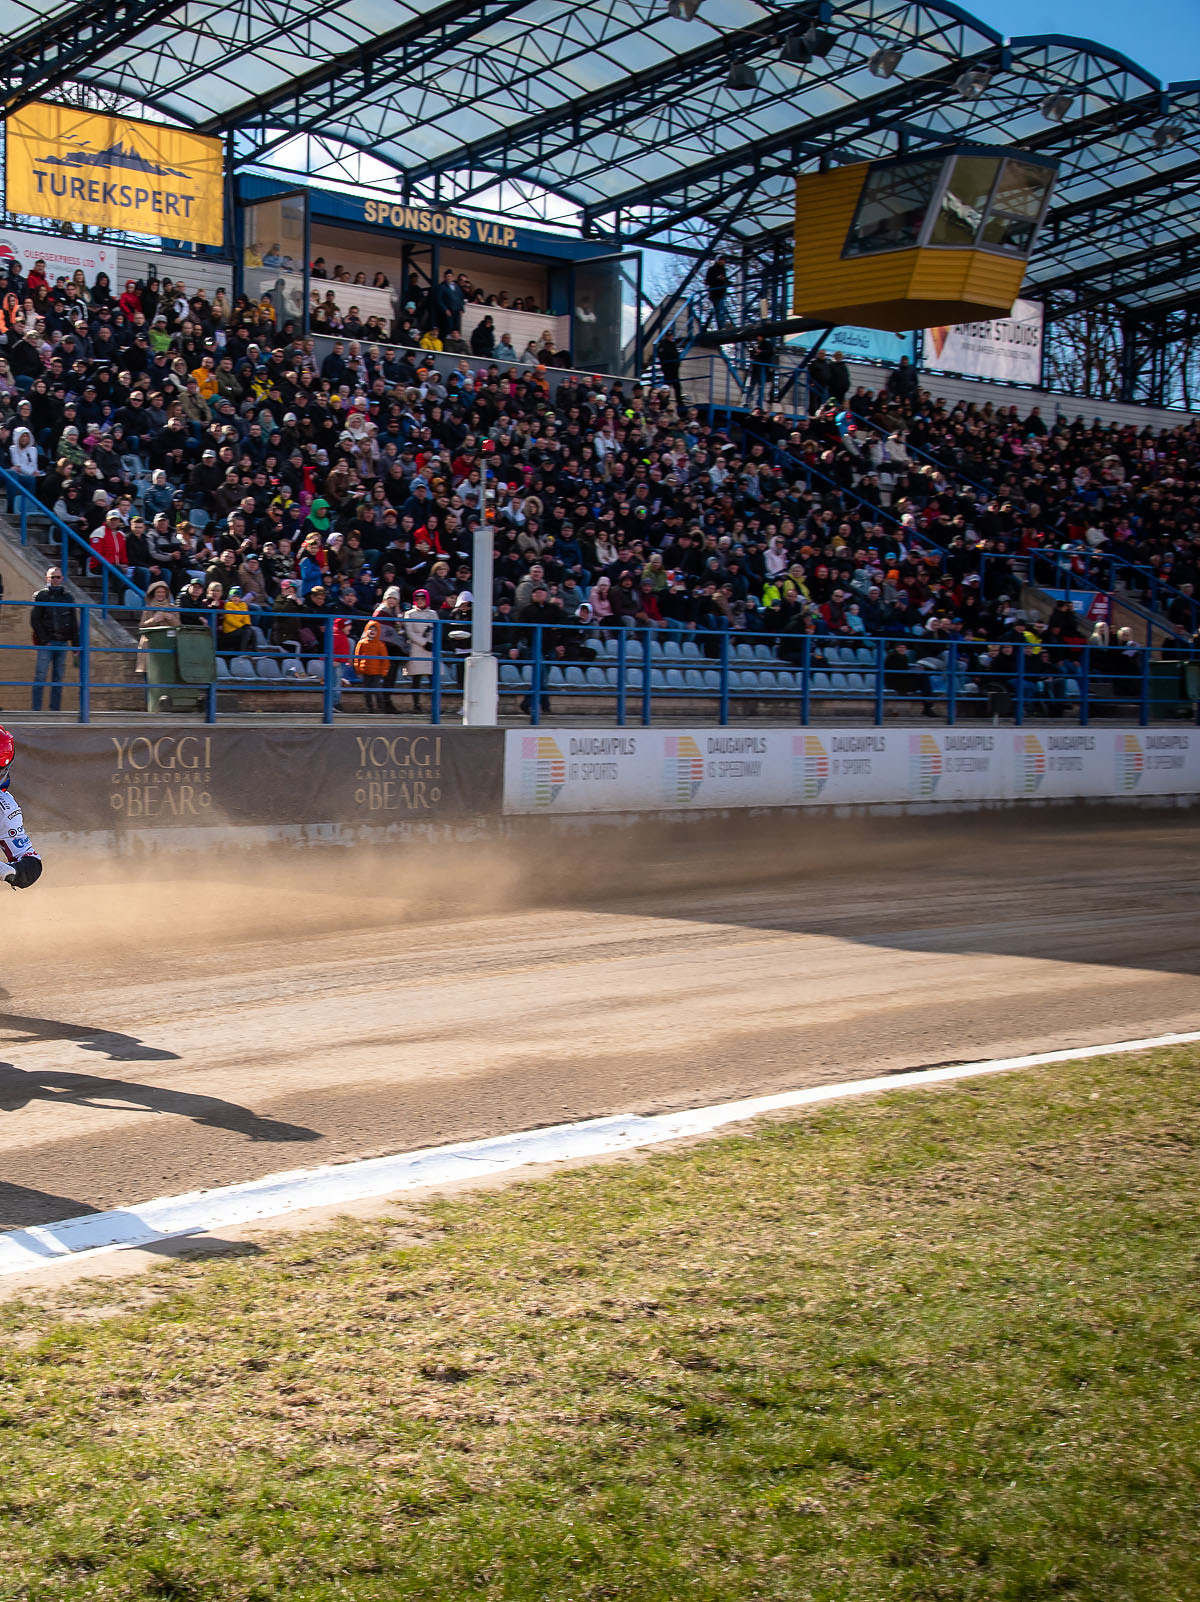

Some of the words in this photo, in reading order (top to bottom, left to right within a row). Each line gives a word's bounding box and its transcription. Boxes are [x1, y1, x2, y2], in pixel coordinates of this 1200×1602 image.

[32, 169, 195, 218] TUREKSPERT
[364, 200, 471, 239] SPONSORS
[475, 221, 518, 248] V.I.P.
[954, 320, 992, 340] AMBER
[995, 322, 1040, 347] STUDIOS
[111, 736, 211, 770] YOGGI
[356, 736, 441, 767] YOGGI
[569, 737, 636, 756] DAUGAVPILS
[707, 737, 766, 755] DAUGAVPILS
[832, 736, 886, 753] DAUGAVPILS
[582, 762, 618, 780] SPORTS
[718, 760, 762, 778] SPEEDWAY
[127, 786, 198, 817] BEAR
[368, 781, 431, 811] BEAR
